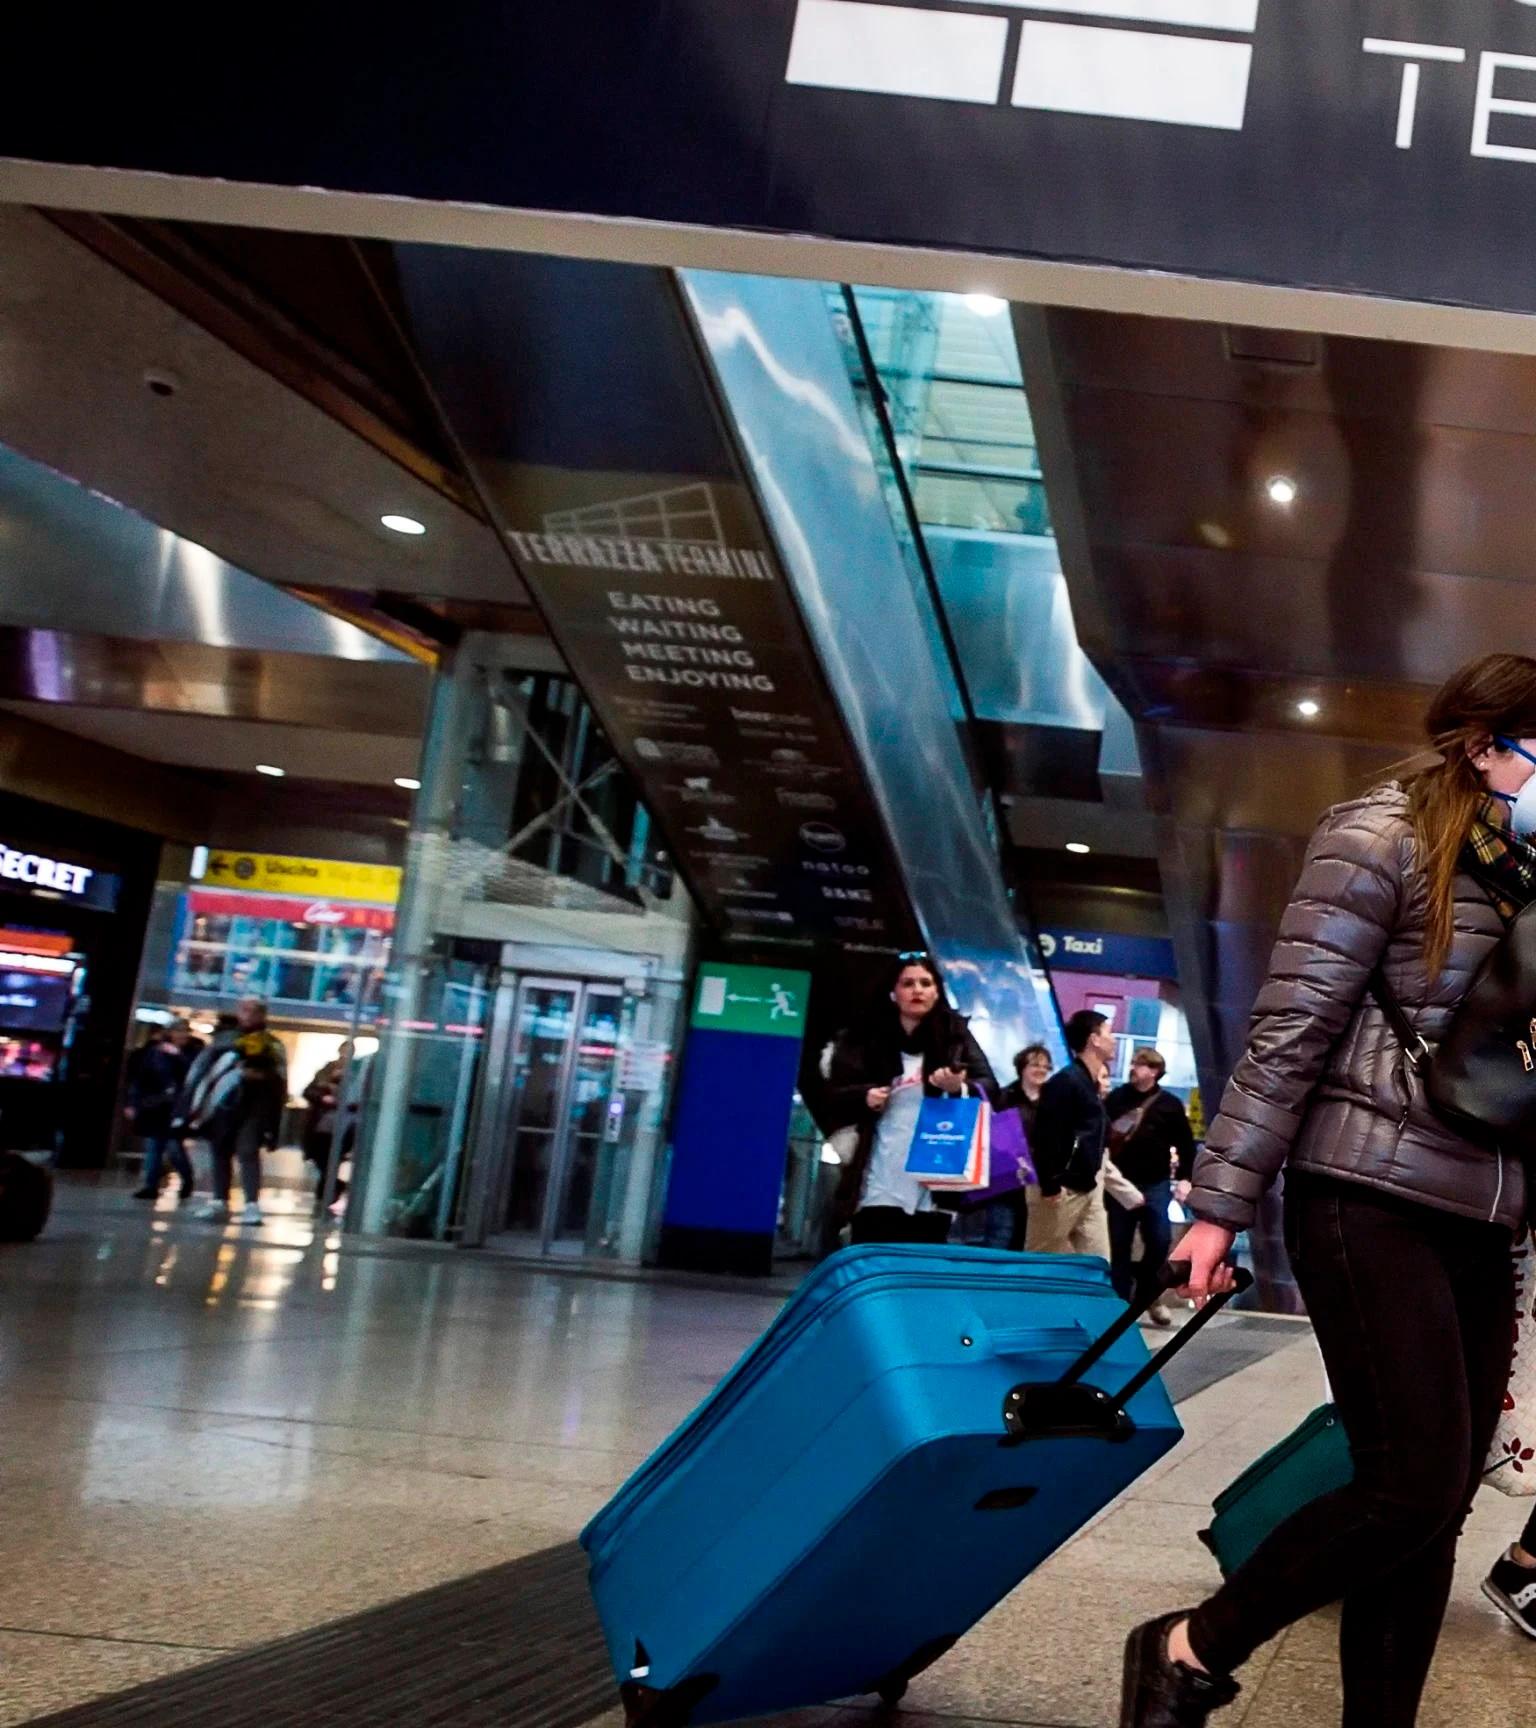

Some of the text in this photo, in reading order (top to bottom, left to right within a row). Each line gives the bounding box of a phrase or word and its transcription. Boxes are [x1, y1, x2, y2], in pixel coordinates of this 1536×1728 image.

[506, 531, 775, 581] TERRAZZA TERMINI
[607, 591, 721, 617] EATING
[607, 616, 744, 644] WAITING
[621, 641, 755, 668] MEETING
[624, 664, 776, 692] ENJOYING
[1062, 935, 1103, 955] Taxi
